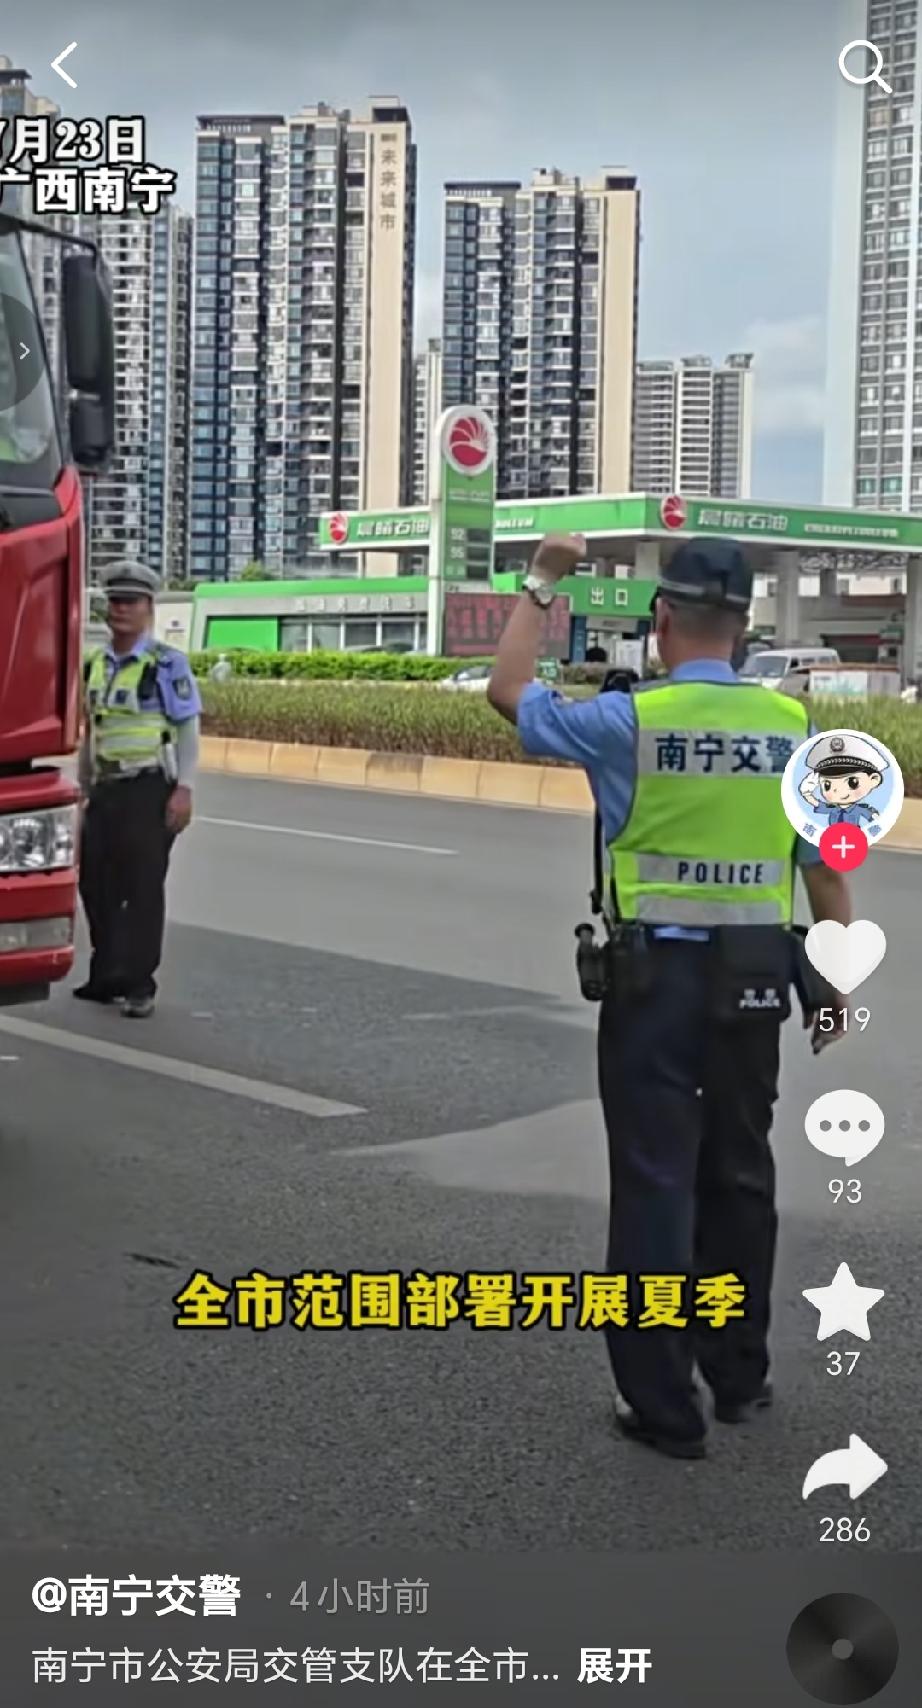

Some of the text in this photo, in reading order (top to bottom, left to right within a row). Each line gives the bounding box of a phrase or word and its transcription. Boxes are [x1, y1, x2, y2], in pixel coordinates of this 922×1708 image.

[591, 586, 628, 605] 出口
[655, 733, 793, 773] 南宁交警
[678, 862, 764, 884] POLICE
